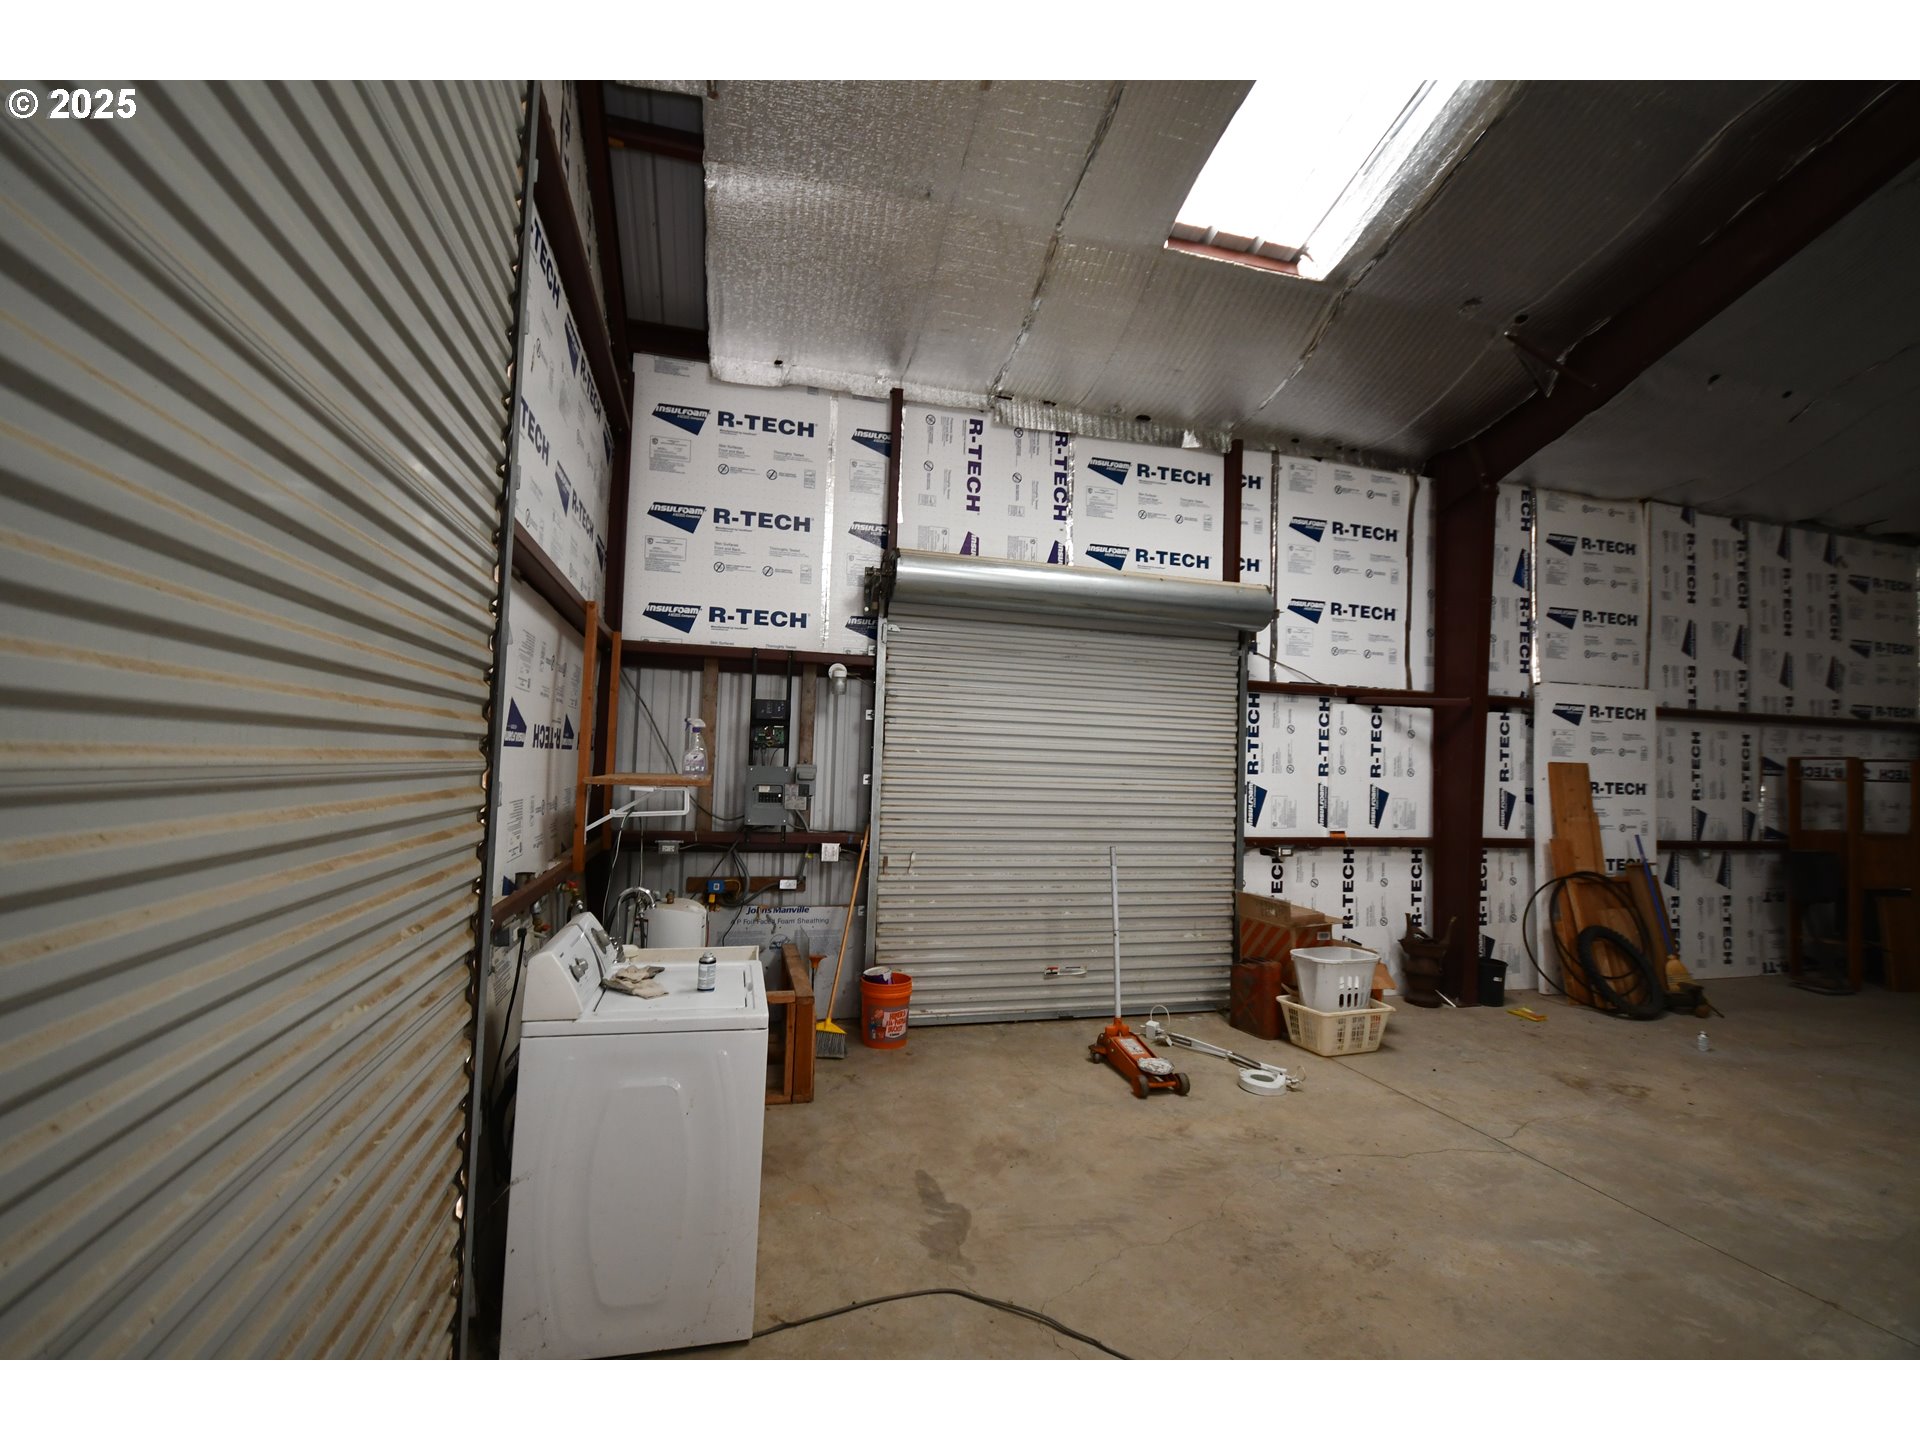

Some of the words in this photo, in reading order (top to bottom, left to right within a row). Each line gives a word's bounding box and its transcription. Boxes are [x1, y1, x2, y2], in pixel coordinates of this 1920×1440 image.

[530, 217, 560, 310] -TECH
[521, 396, 549, 466] TECH
[717, 410, 815, 438] R-TECH
[855, 430, 891, 441] INSULFO
[966, 418, 984, 512] R-TECH
[1053, 431, 1069, 521] R-TECH
[1136, 463, 1211, 486] R-TECH
[572, 488, 594, 541] R-TECH
[713, 507, 811, 532] R-TECH
[851, 523, 888, 533] INSULFO
[1521, 490, 1531, 531] ECH
[1332, 521, 1398, 542] R-TECH
[1581, 537, 1637, 555] R-TECH
[1135, 548, 1210, 569] R-TECH
[1687, 533, 1696, 604] R-TECH
[708, 606, 808, 629] R-TECH
[848, 617, 878, 628] INSULF
[1330, 602, 1397, 621] R-TECH
[1582, 609, 1638, 626] R-TECH
[1519, 597, 1530, 674] R-TECH
[1687, 666, 1696, 710] R-TE
[1590, 705, 1647, 721] R-TECH
[1247, 693, 1260, 775] R-TECH
[1318, 697, 1331, 777] R-TECH
[1370, 704, 1382, 778] R-TECH
[1499, 711, 1510, 782] R-TECH
[1691, 731, 1701, 801] R-TECH
[1590, 782, 1647, 795] R-TECH
[1342, 849, 1354, 929] R-TECH
[1411, 849, 1422, 927] R-TECH
[773, 905, 810, 914] Manville
[797, 917, 830, 926] Sheathing
[1723, 895, 1733, 965] R-TECH
